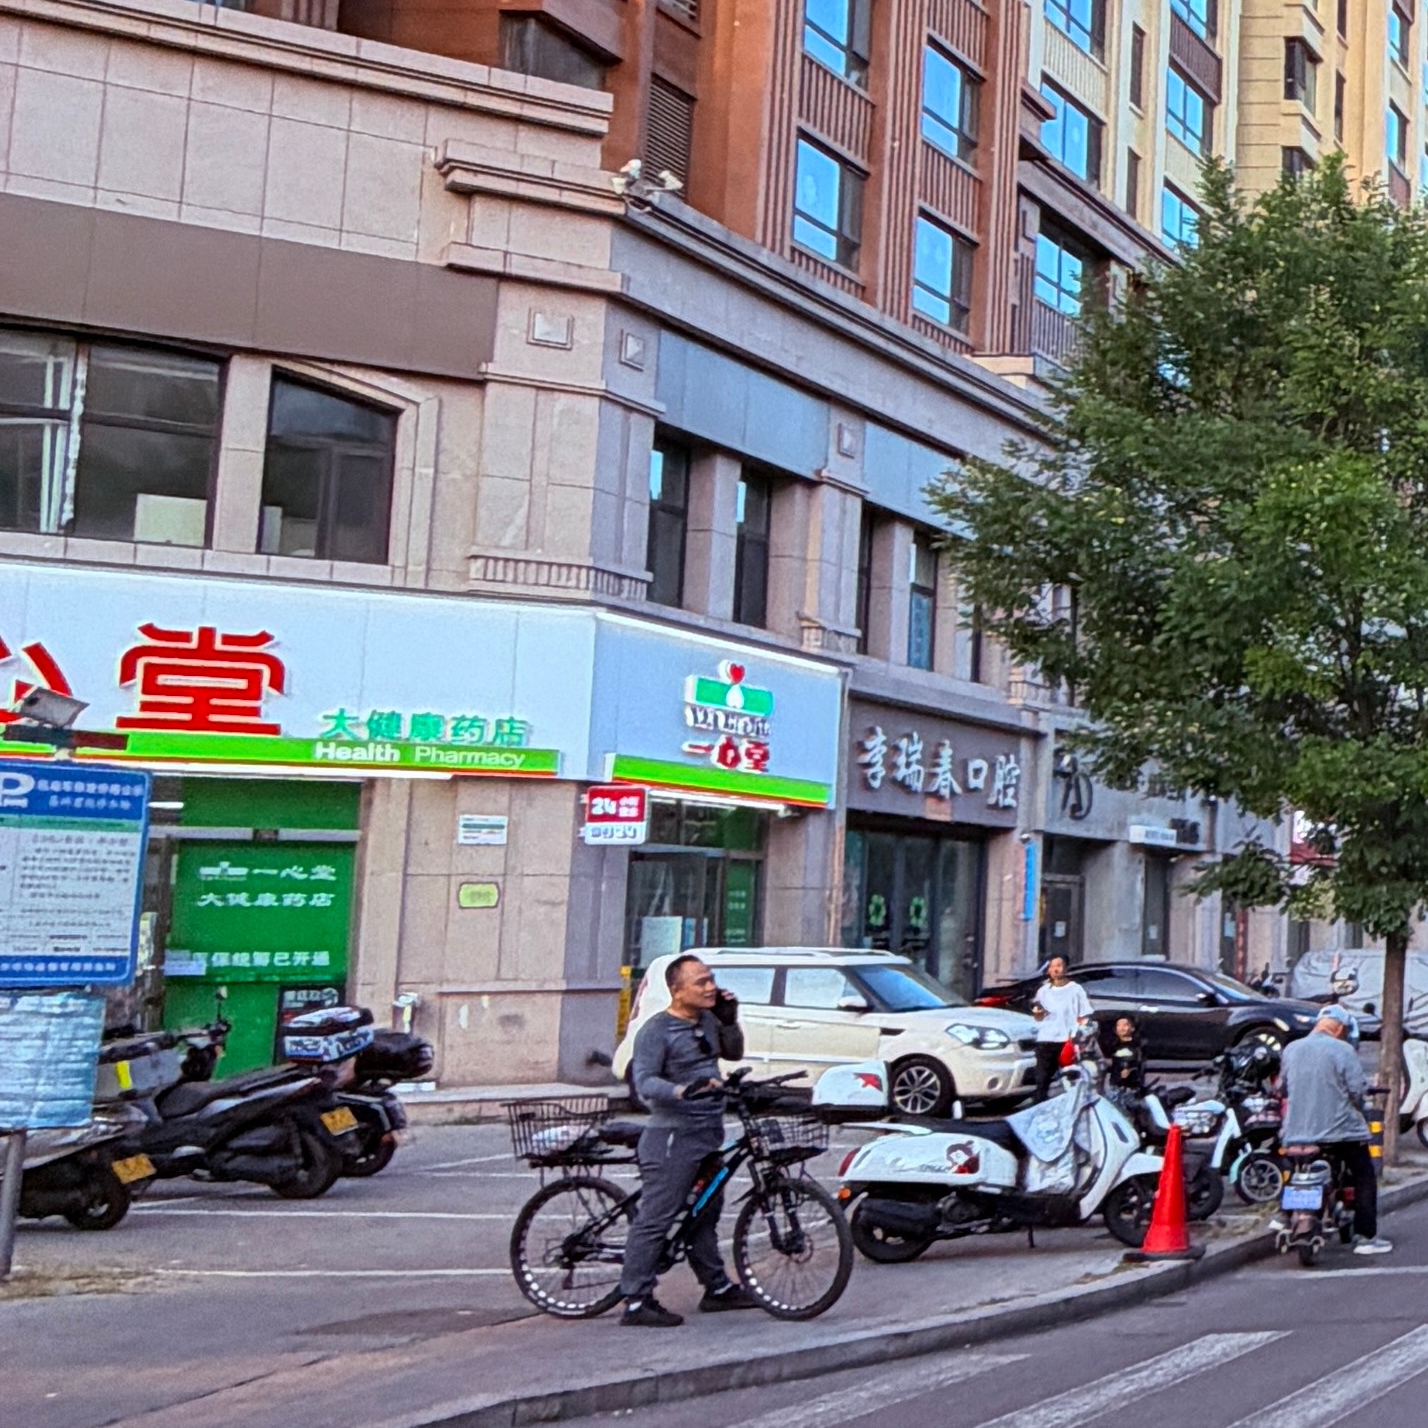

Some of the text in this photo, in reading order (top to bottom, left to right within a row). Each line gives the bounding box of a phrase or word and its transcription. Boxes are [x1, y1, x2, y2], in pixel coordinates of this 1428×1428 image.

[320, 708, 529, 745] 大健康药店
[315, 742, 525, 767] Health Pharmacy
[684, 735, 770, 773] 一心堂
[857, 726, 1020, 807] 李瑞春口腔
[252, 865, 336, 881] 一心堂
[197, 892, 335, 907] 大健康药店
